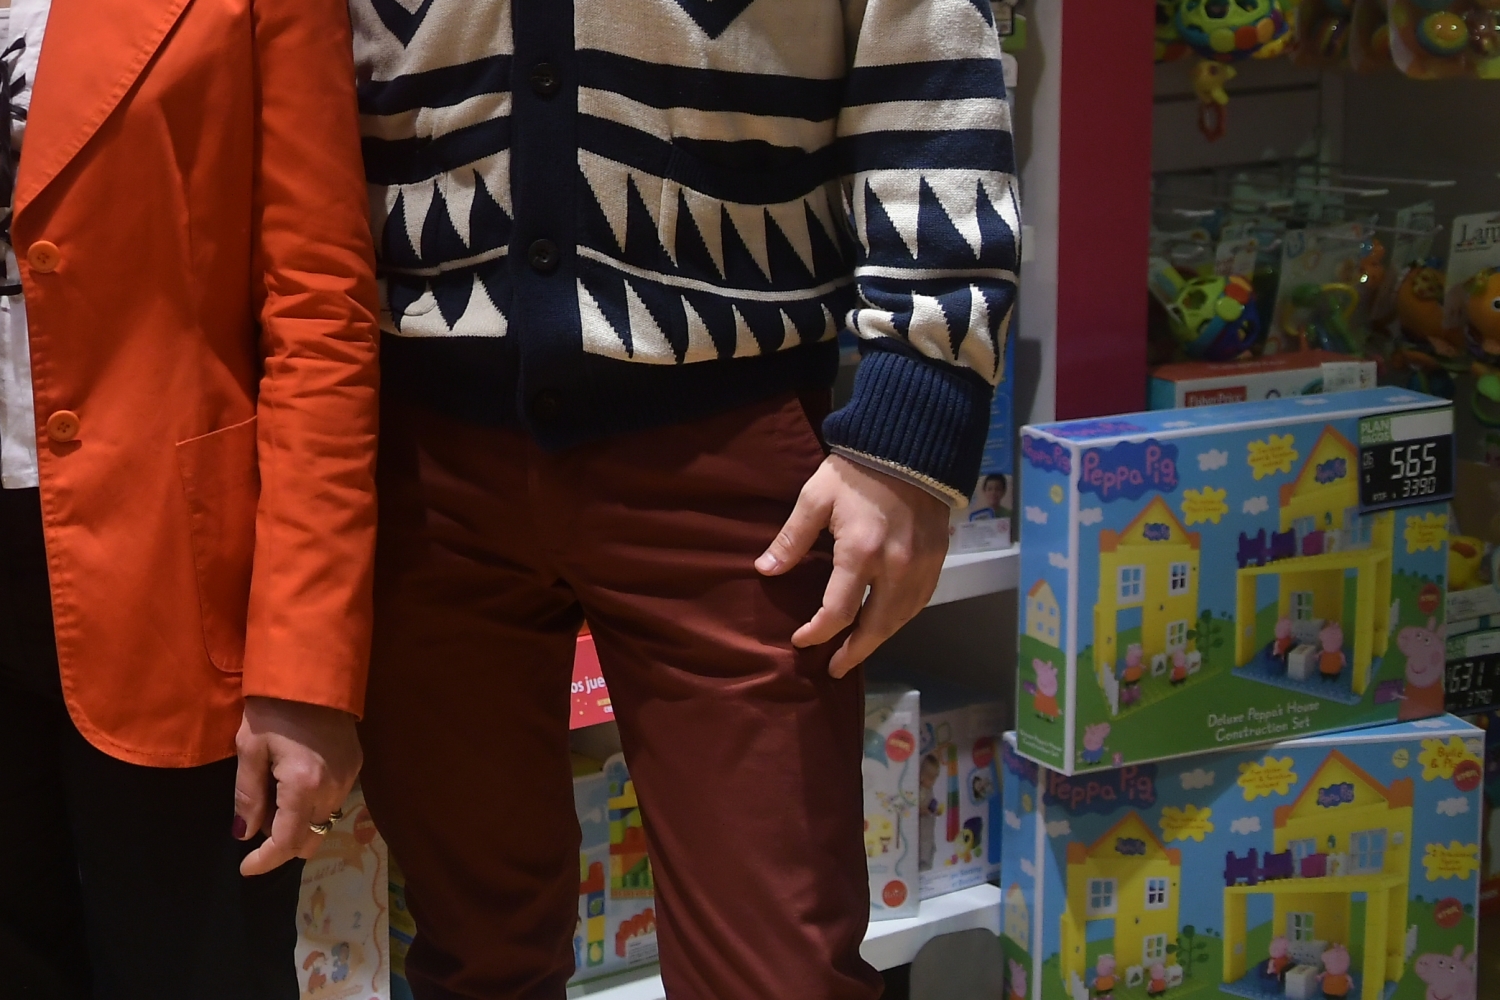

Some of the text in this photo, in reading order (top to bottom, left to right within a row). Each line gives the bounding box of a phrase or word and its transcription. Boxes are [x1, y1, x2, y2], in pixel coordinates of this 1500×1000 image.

[1083, 444, 1177, 497] Peppa Pig
[1391, 442, 1437, 480] 565
[1402, 478, 1436, 496] 3390
